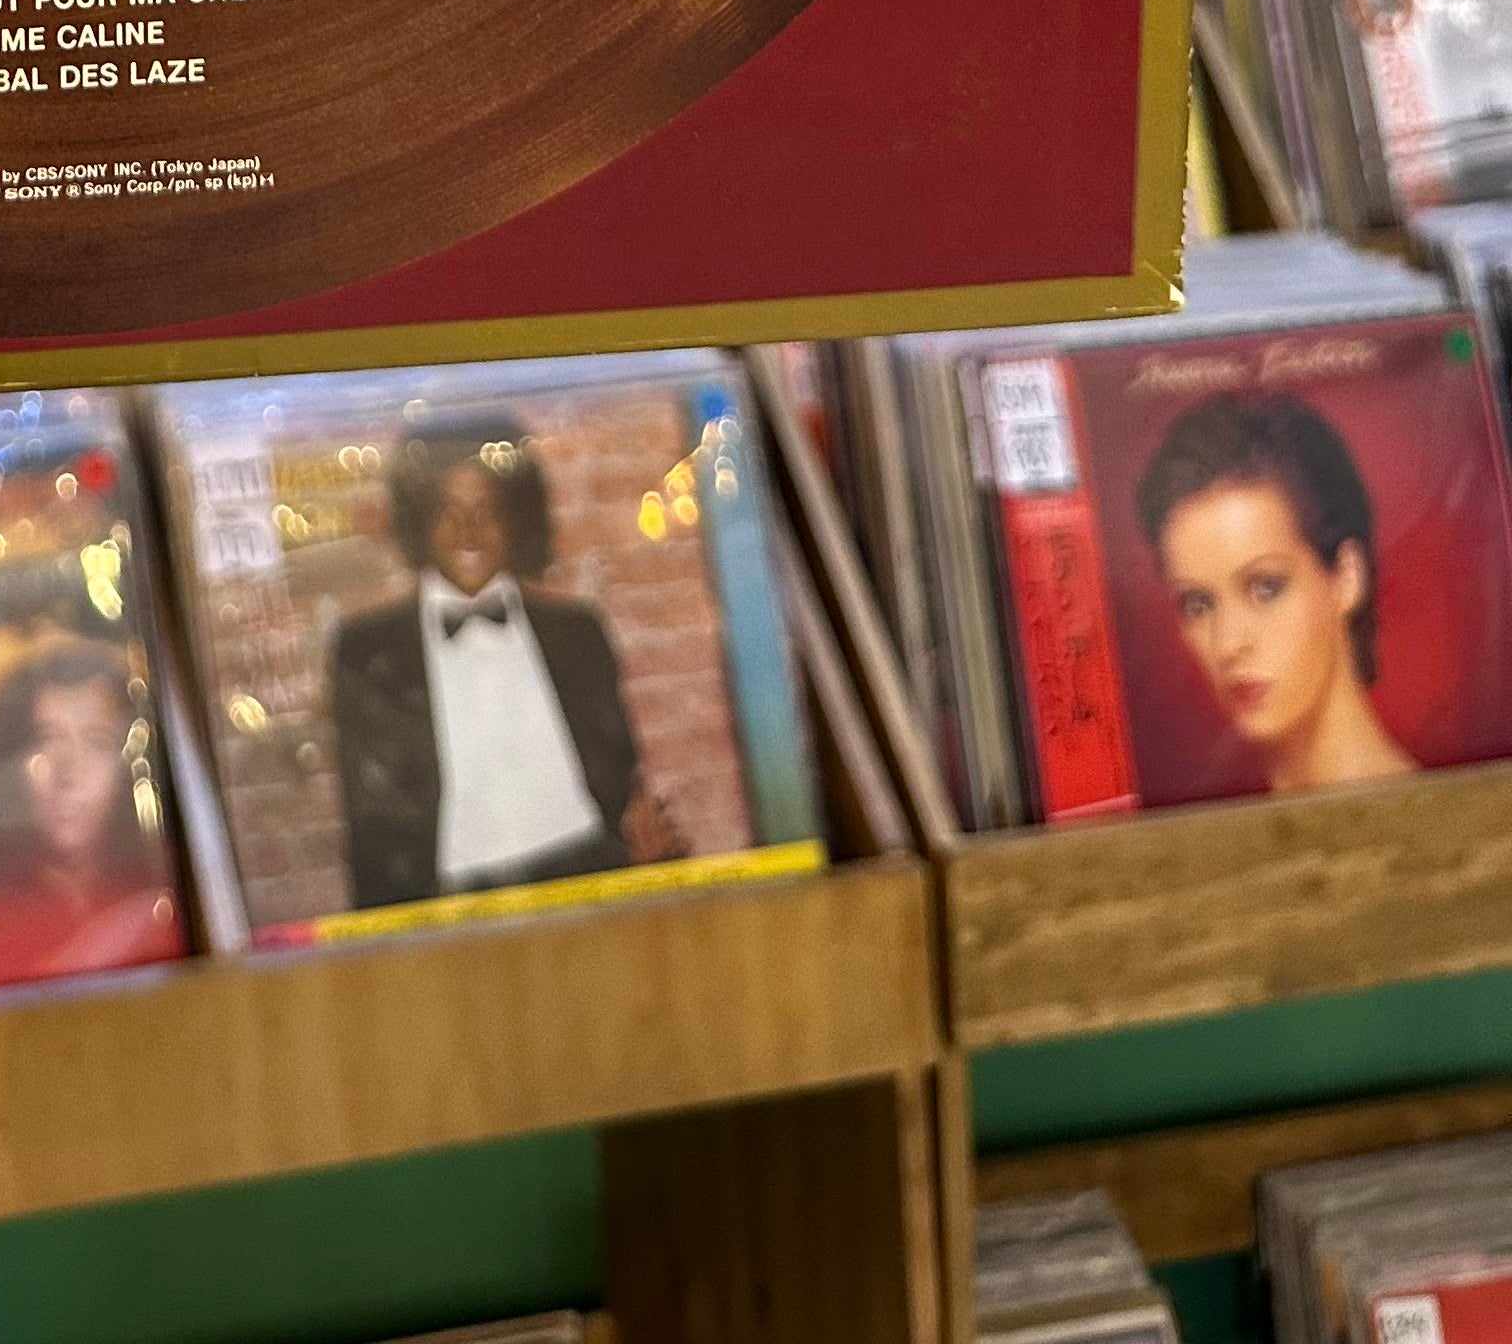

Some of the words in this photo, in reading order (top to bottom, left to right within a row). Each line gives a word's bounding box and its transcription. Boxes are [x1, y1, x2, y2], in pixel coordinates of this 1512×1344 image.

[56, 20, 165, 50] CALINE
[60, 62, 119, 90] DES
[130, 57, 206, 86] LAZE
[1, 169, 21, 185] by
[25, 163, 108, 182] CBS/SONY
[113, 161, 147, 177] INC.
[150, 159, 204, 177] (Tokyo
[207, 155, 261, 174] Japan)
[4, 184, 63, 200] SONY
[83, 181, 122, 196] Sony
[226, 172, 257, 191] (kp)
